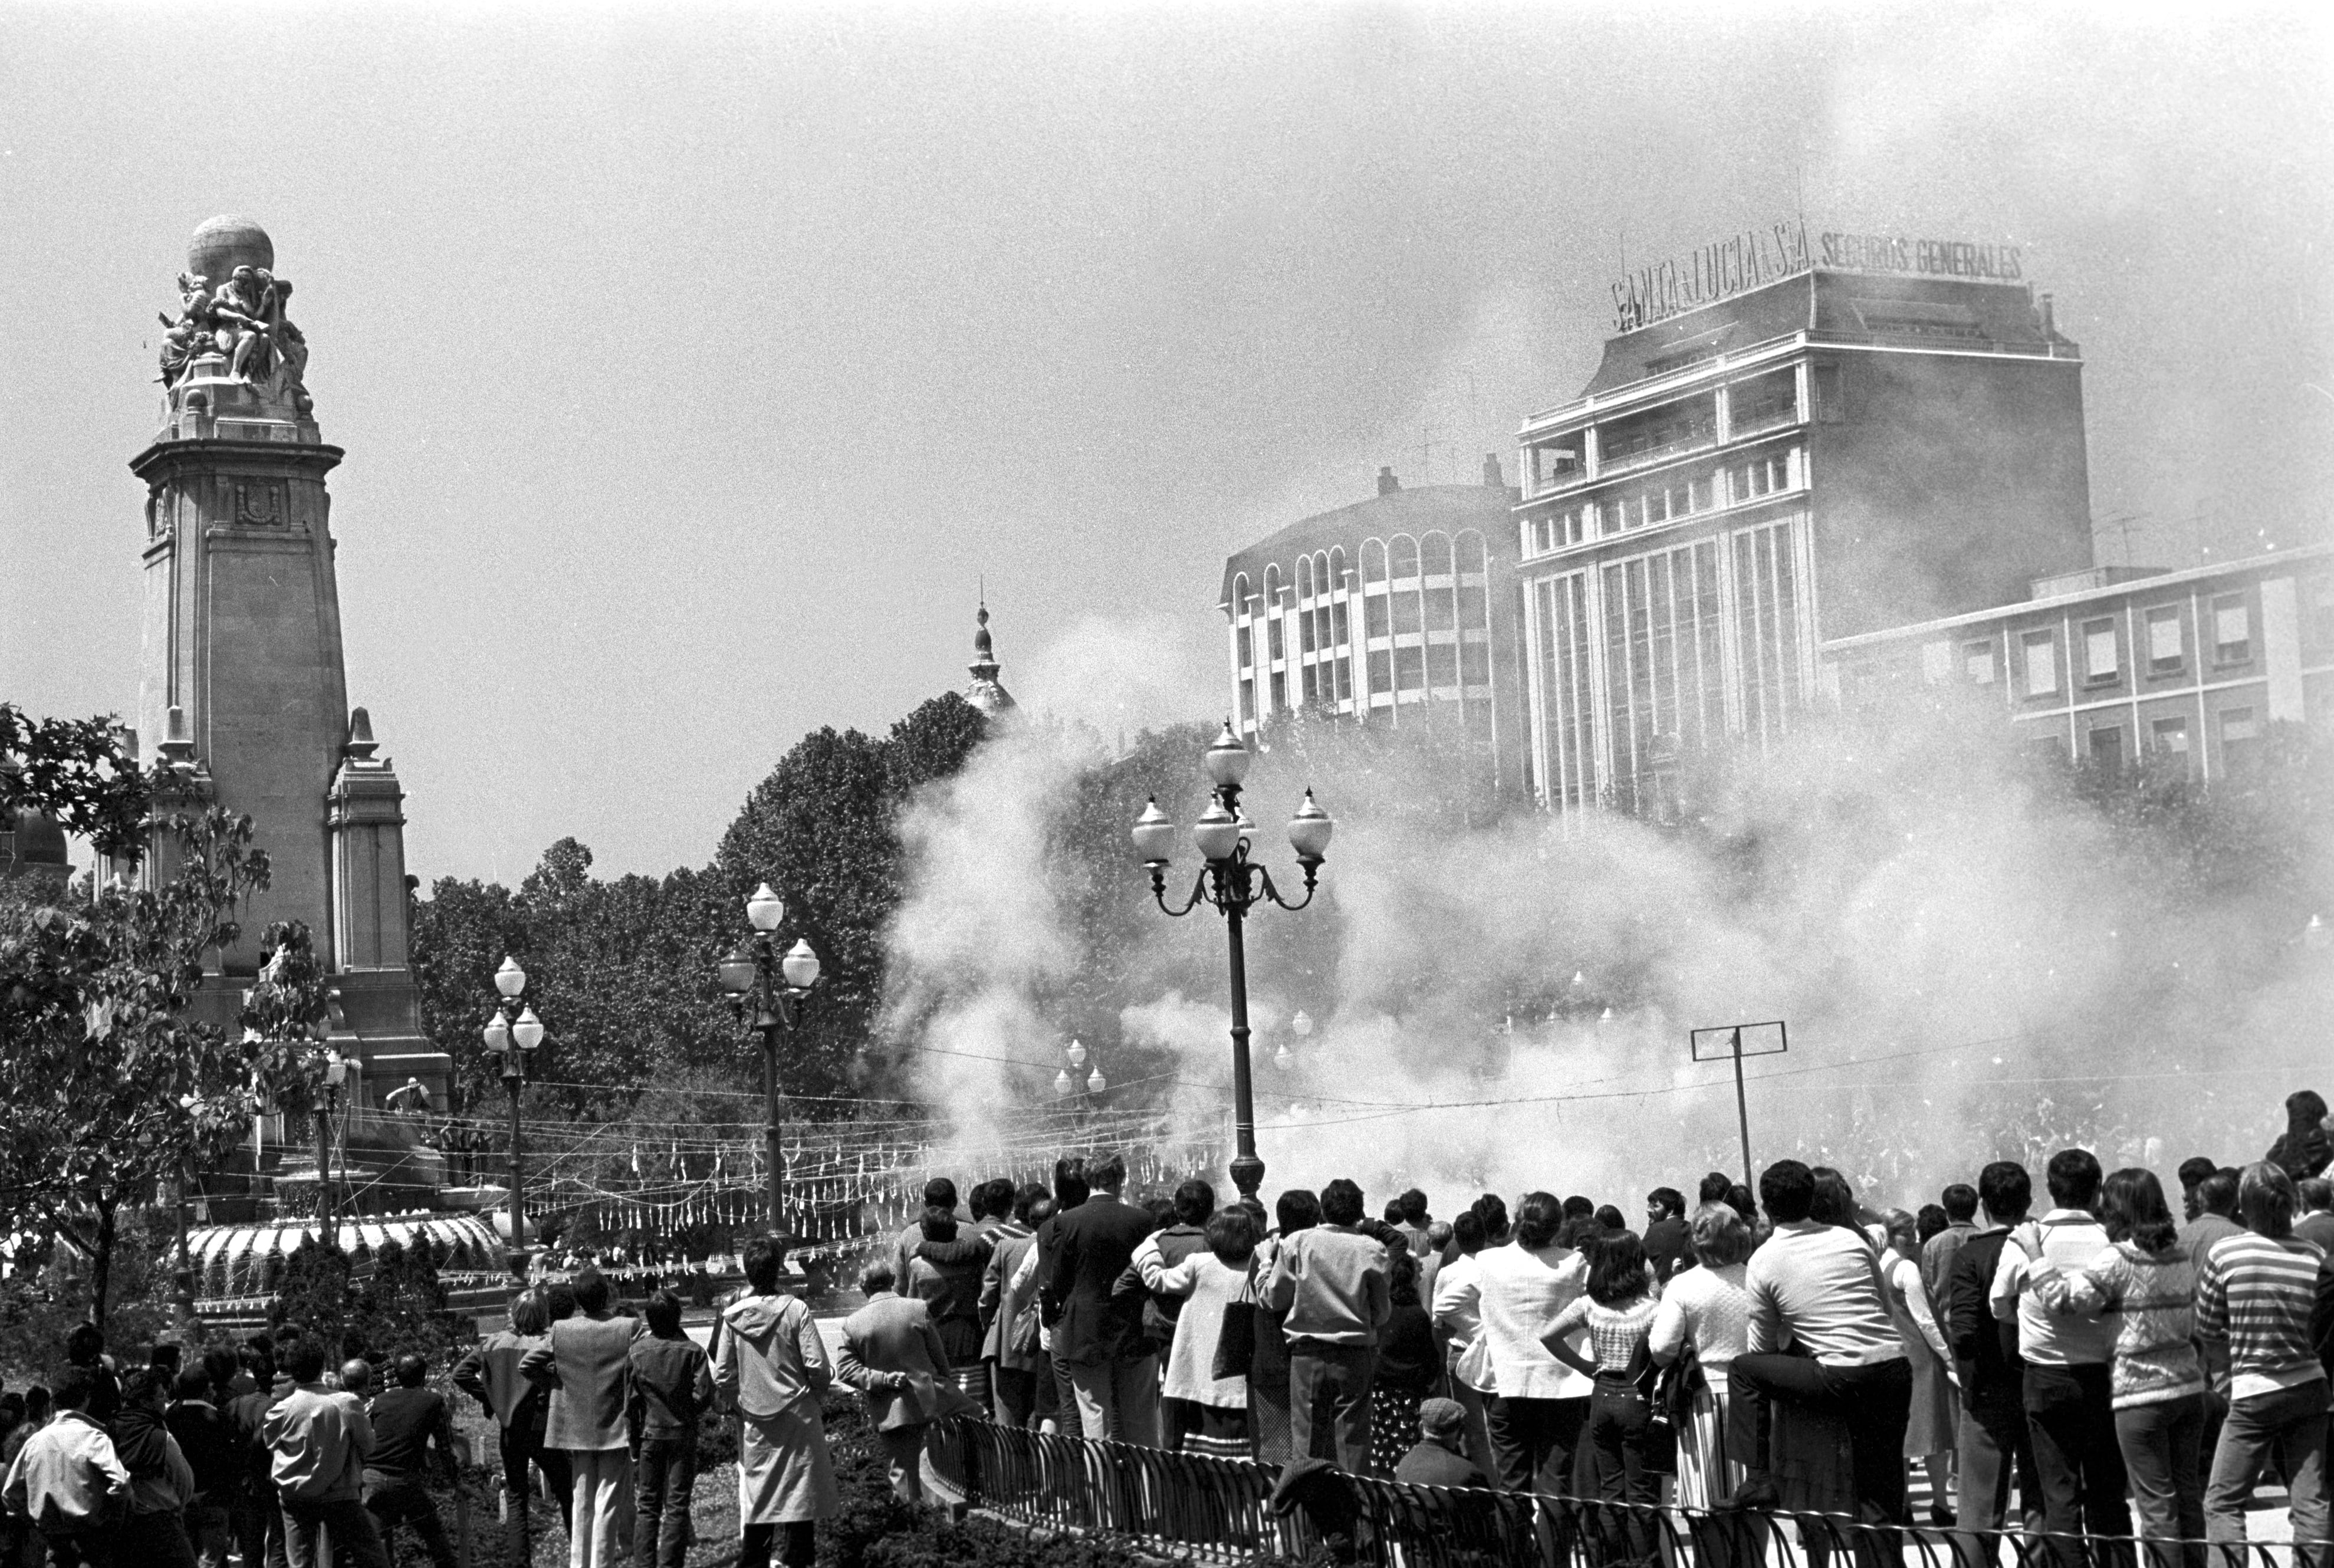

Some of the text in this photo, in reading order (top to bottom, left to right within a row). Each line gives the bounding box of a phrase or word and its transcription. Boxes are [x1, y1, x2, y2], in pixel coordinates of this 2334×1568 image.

[1822, 232, 2021, 279] SEGUROS GENERALES
[1612, 260, 1680, 333] SANTA
